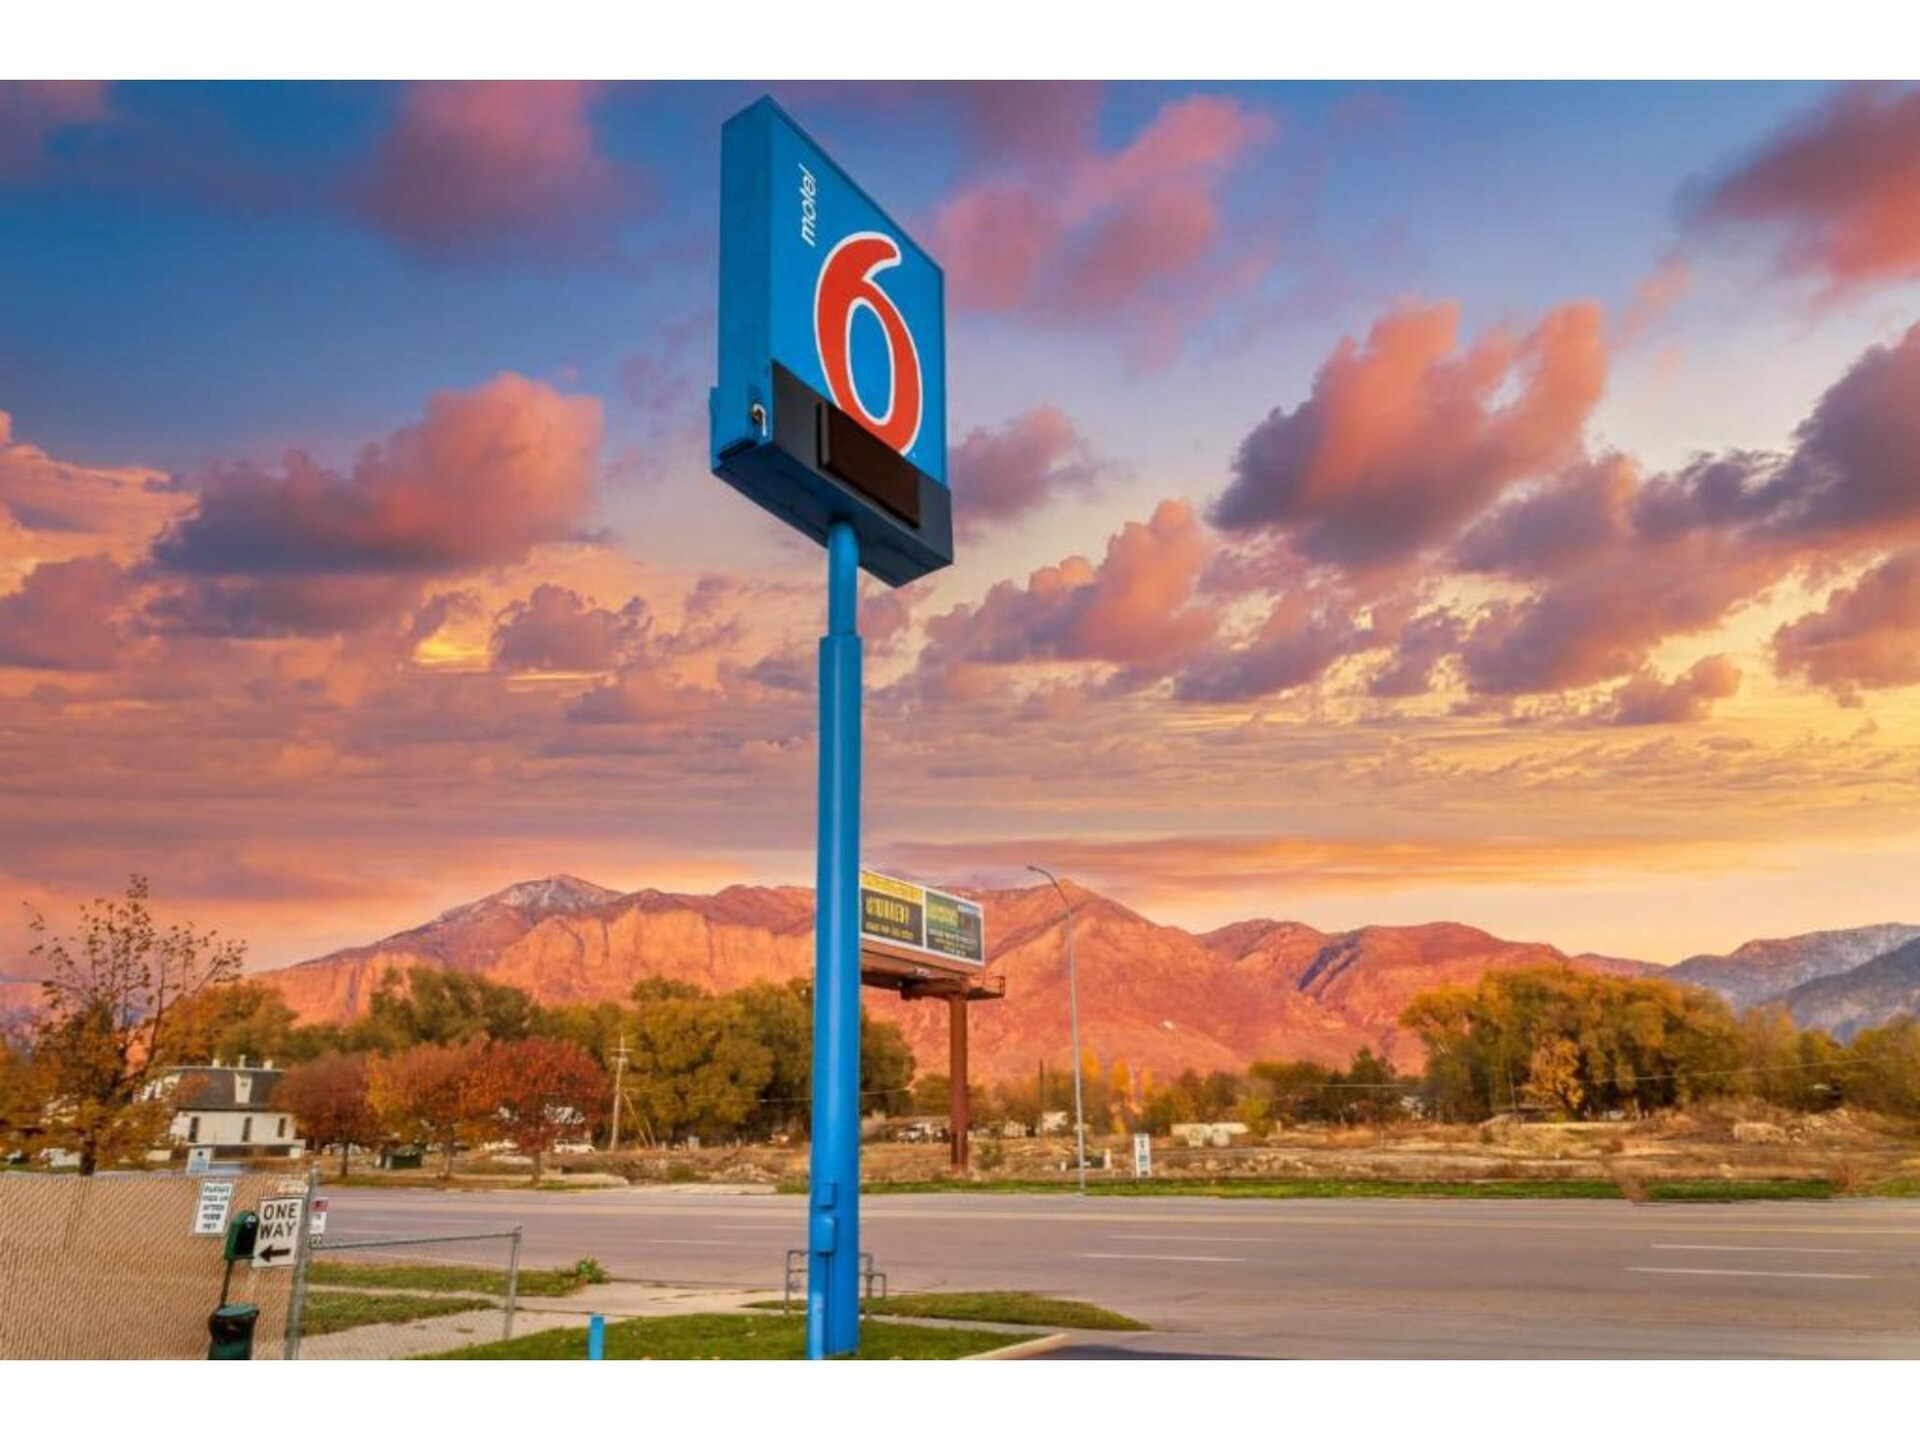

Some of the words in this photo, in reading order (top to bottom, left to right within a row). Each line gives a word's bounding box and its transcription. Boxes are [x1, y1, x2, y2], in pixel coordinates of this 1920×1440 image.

[798, 162, 817, 248] motel
[814, 231, 923, 457] 6
[260, 1221, 297, 1239] WAY
[263, 1202, 298, 1220] ONE
